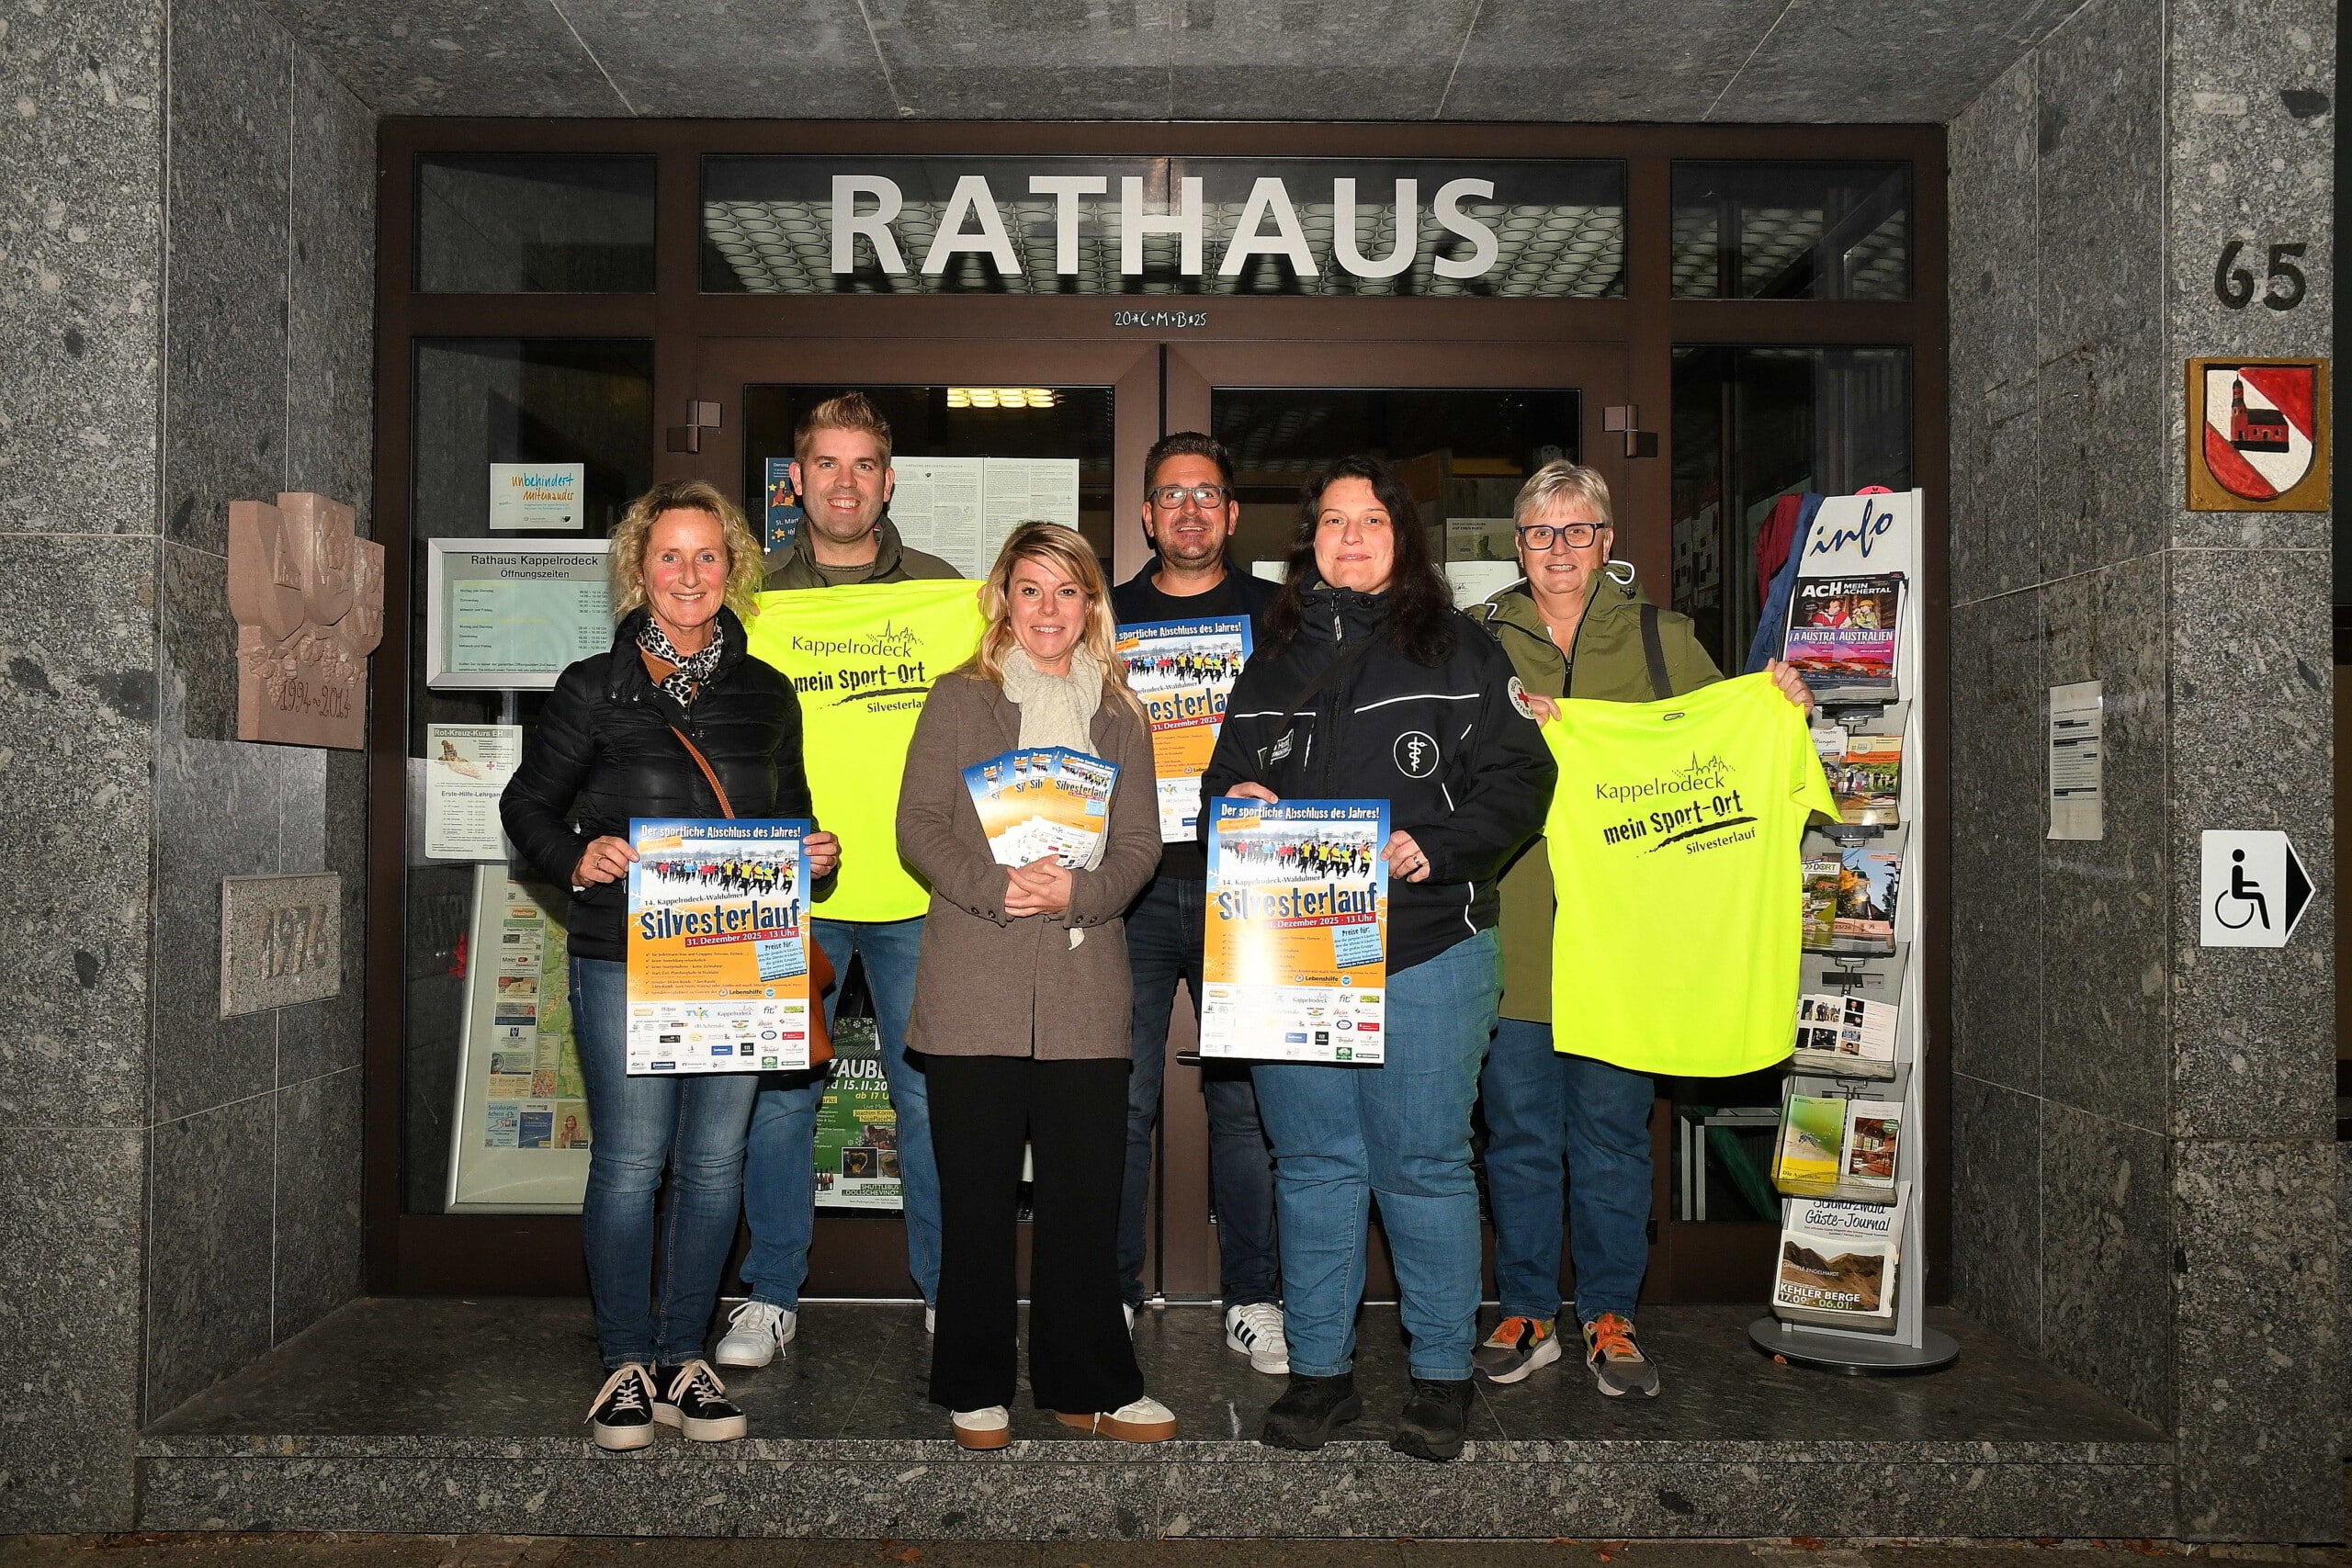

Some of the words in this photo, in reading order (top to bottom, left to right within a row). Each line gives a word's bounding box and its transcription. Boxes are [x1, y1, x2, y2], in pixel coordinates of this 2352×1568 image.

[831, 175, 1499, 278] RATHAUS
[2214, 241, 2307, 311] 65
[1810, 498, 1894, 558] info
[470, 555, 517, 566] Rathaus
[520, 555, 599, 568] Kappelrodeck
[501, 568, 570, 580] Öffnungszeiten
[1802, 581, 1842, 598] ACH
[1842, 587, 1892, 595] ACHERTAL
[1118, 628, 1158, 640] sportliche
[1159, 626, 1198, 637] Abschluss
[1199, 625, 1213, 634] des
[1215, 622, 1242, 633] Jahres!
[1801, 631, 1836, 641] AUSTRA
[1838, 631, 1893, 641] AUSTRALIEN
[792, 636, 912, 658] Kappelrodeck
[793, 671, 833, 693] mein
[838, 661, 925, 691] Sport-Ort
[1137, 682, 1198, 694] elrodeck-Waldulmer
[867, 698, 925, 713] Silvesterla
[1148, 687, 1231, 721] esterla
[1164, 720, 1198, 729] Dezember
[1200, 716, 1217, 725] 2025
[441, 791, 502, 799] Erste-Hilfe-Lehrgan
[1596, 772, 1725, 803] Kappelrodeck
[1221, 804, 1237, 817] Der
[1238, 805, 1283, 818] sportliche
[1285, 807, 1329, 818] Abschluss
[1331, 807, 1346, 818] des
[1348, 807, 1380, 819] Jahres!
[1603, 818, 1647, 845] mein
[1650, 789, 1744, 834] Sport-Ort
[641, 824, 657, 837] Der
[660, 825, 705, 838] sportliche
[707, 826, 751, 838] Abschluss
[752, 827, 768, 838] des
[771, 826, 801, 838] Jahres!
[1686, 827, 1757, 855] Silvesterlauf
[657, 892, 743, 907] Kappelrodeck-Waldulmer
[640, 897, 800, 940] Silvesterlauf
[1278, 919, 1317, 929] Dezember
[1320, 917, 1339, 926] 2025
[1358, 914, 1373, 922] Uhr
[687, 938, 698, 946] 31.
[700, 935, 741, 945] Dezember
[742, 932, 762, 941] 2025
[780, 929, 796, 937] Uhr
[843, 1079, 888, 1090] 15.11.20
[1805, 1209, 1891, 1232] Gäste-Journal
[1805, 1267, 1839, 1278] ENGELHARDT
[1780, 1282, 1821, 1299] KEHLER
[1824, 1291, 1860, 1303] BERGE
